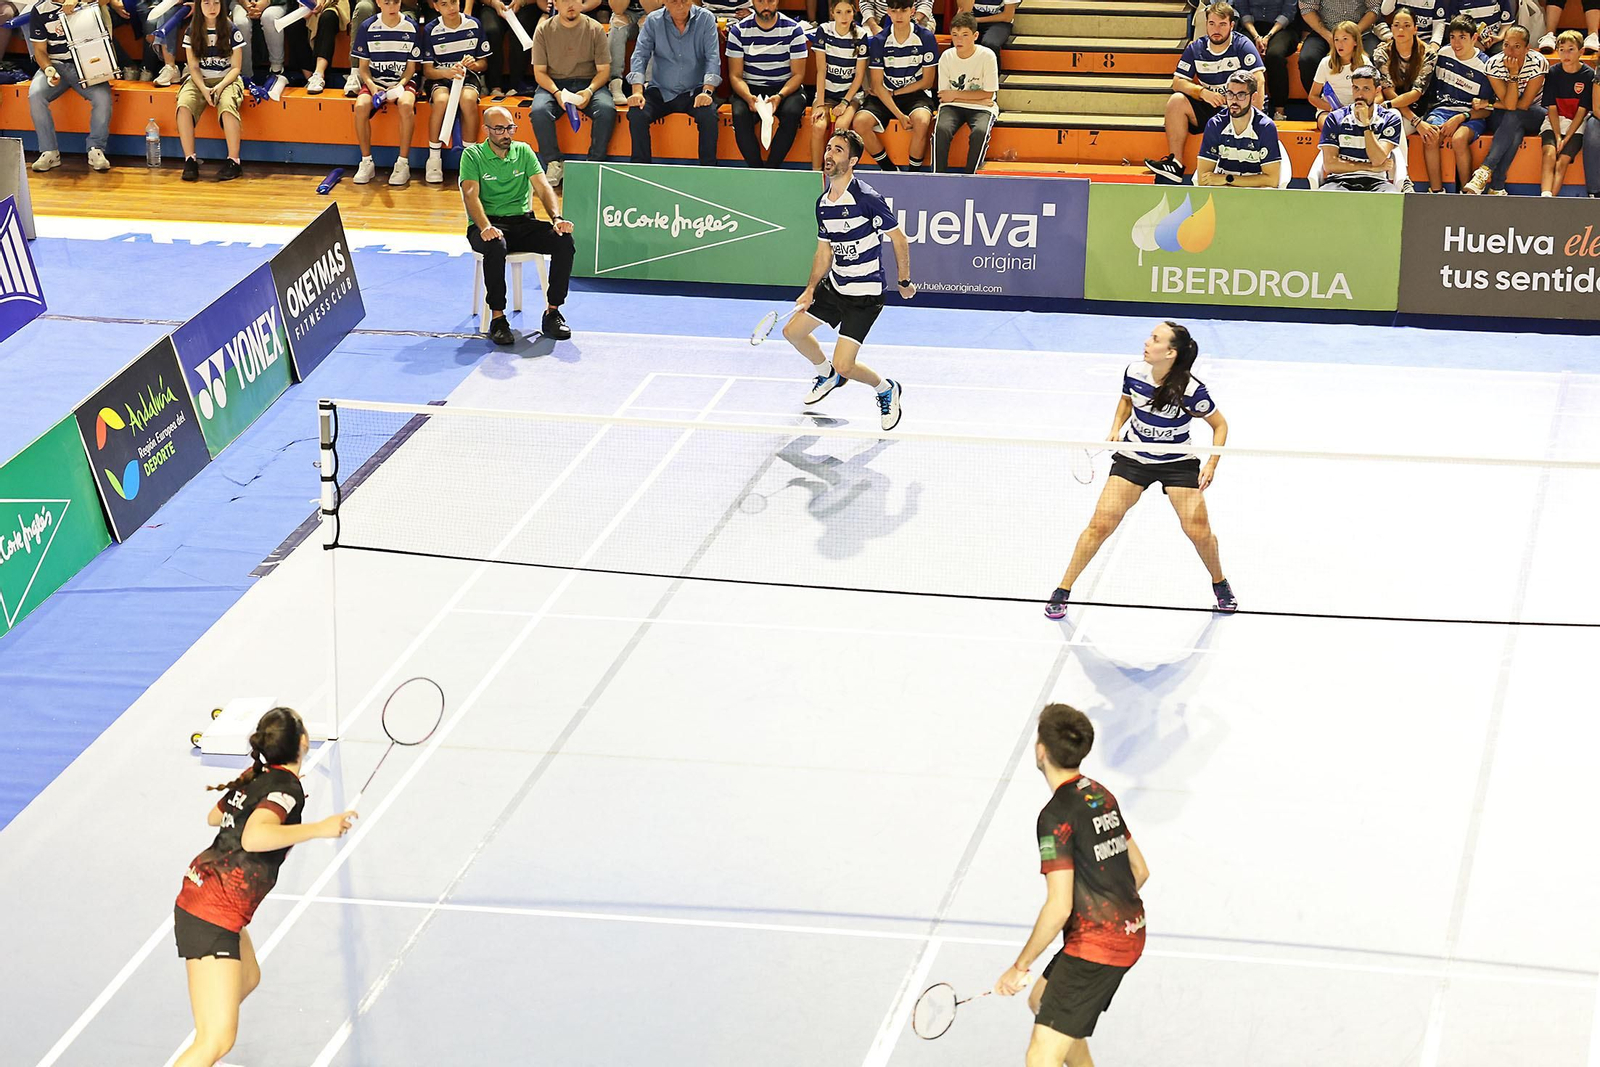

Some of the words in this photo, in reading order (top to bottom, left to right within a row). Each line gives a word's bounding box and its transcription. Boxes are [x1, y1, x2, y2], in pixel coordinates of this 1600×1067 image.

[1072, 52, 1083, 68] F
[1103, 53, 1115, 68] 8
[515, 112, 521, 120] 6
[1057, 130, 1069, 145] F
[1089, 130, 1100, 145] 7
[1296, 136, 1312, 145] 22
[602, 205, 622, 228] El
[623, 207, 669, 230] Corte
[671, 203, 738, 238] Inglés
[1444, 226, 1554, 255] Huelva
[972, 253, 1037, 273] original
[286, 242, 346, 318] OKEYMAS
[914, 281, 1002, 294] w.huelvaoriginal.com
[1151, 266, 1353, 299] IBERDROLA
[1440, 265, 1489, 290] tus
[1495, 266, 1600, 293] sentid
[294, 298, 332, 341] FITNESS
[331, 277, 353, 305] CLUB
[225, 305, 284, 390] YONEX
[129, 374, 179, 436] Andalucía
[138, 438, 157, 459] Región
[155, 421, 178, 443] Europea
[176, 410, 186, 426] del
[143, 440, 176, 477] DEPORTE
